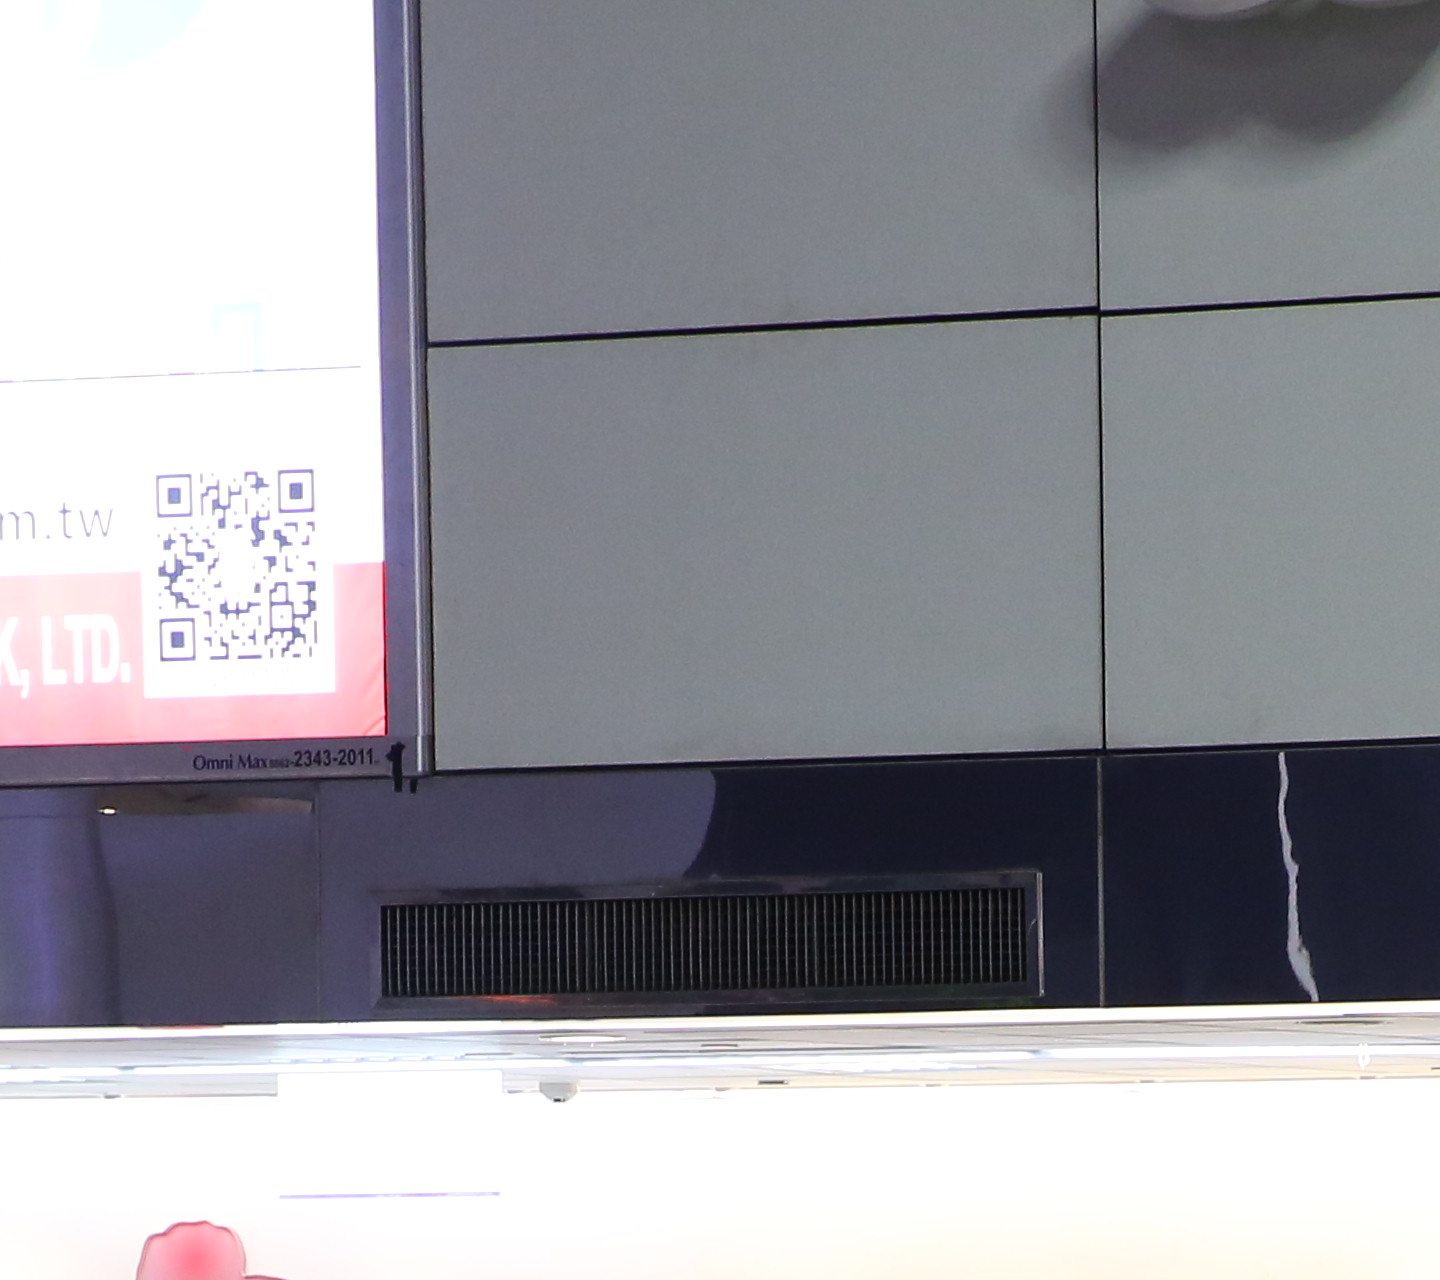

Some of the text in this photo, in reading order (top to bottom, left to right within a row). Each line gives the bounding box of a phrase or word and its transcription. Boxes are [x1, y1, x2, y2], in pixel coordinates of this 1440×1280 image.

[41, 613, 131, 685] LTD.
[193, 752, 233, 771] Omni
[238, 753, 268, 770] Max
